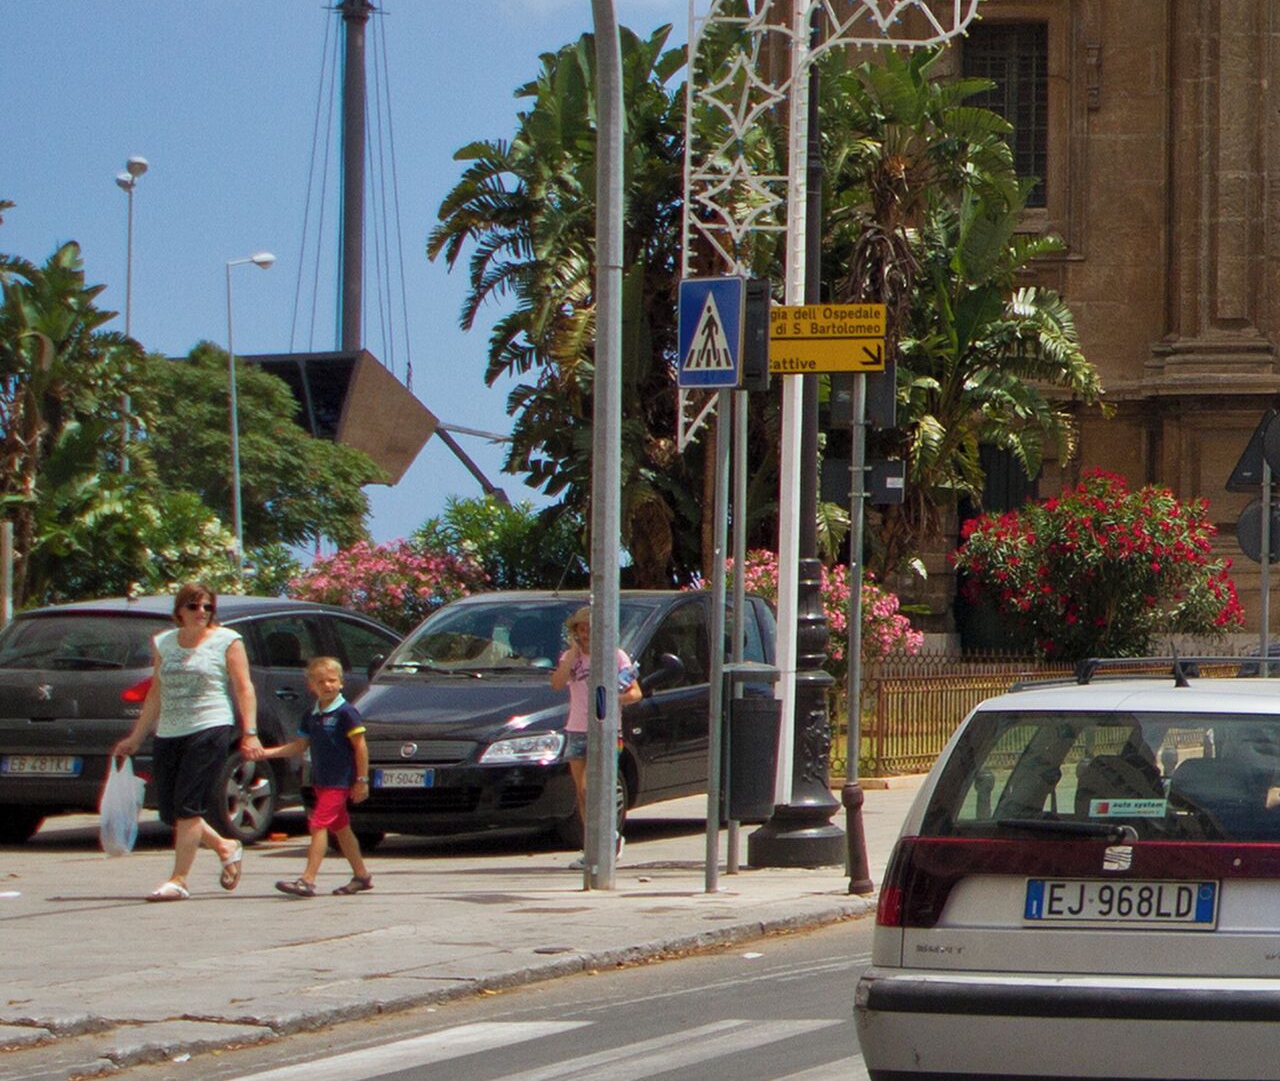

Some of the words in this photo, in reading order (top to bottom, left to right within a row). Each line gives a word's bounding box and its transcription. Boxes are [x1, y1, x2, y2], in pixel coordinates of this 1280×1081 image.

[770, 309, 788, 322] gia
[822, 306, 881, 321] Ospedale
[776, 323, 787, 335] di
[810, 322, 881, 335] Bartolomeo
[1048, 883, 1085, 916] EJ
[1098, 884, 1194, 918] 968LD
